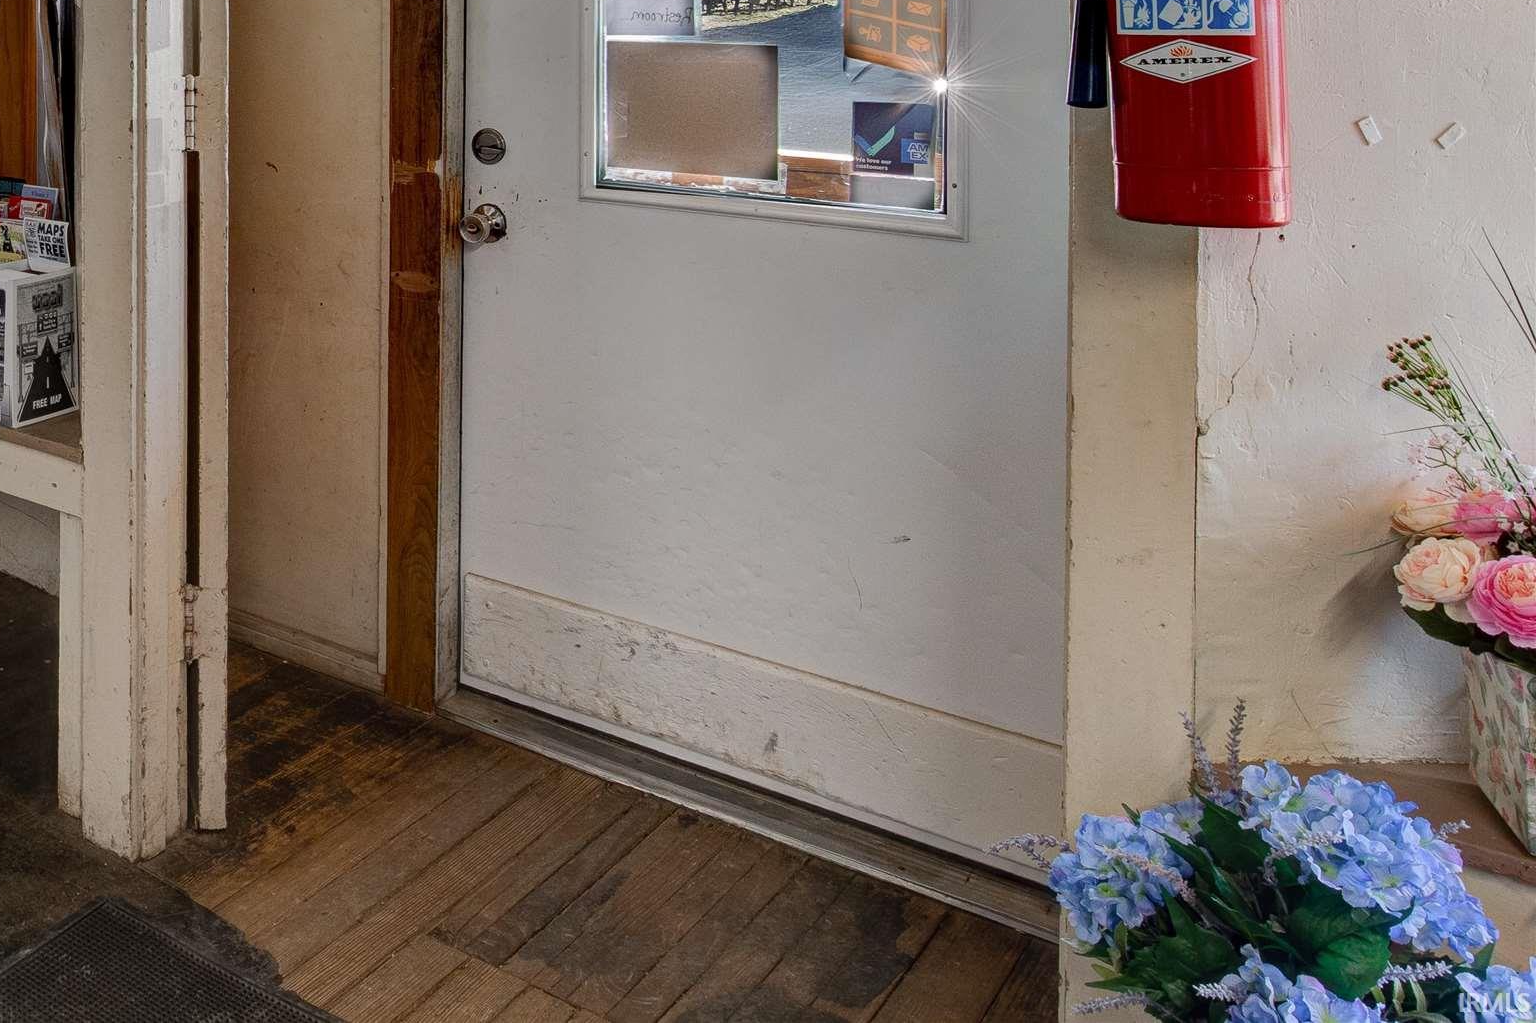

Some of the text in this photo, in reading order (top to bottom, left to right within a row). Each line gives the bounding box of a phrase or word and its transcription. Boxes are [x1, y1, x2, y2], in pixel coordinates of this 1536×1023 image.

[1137, 56, 1233, 66] AMEREX
[909, 142, 929, 152] AM
[911, 151, 929, 161] EX
[37, 222, 65, 236] MAPS
[37, 234, 64, 244] TAKE ONE
[39, 243, 66, 258] FREE
[32, 393, 62, 410] FREE MAP
